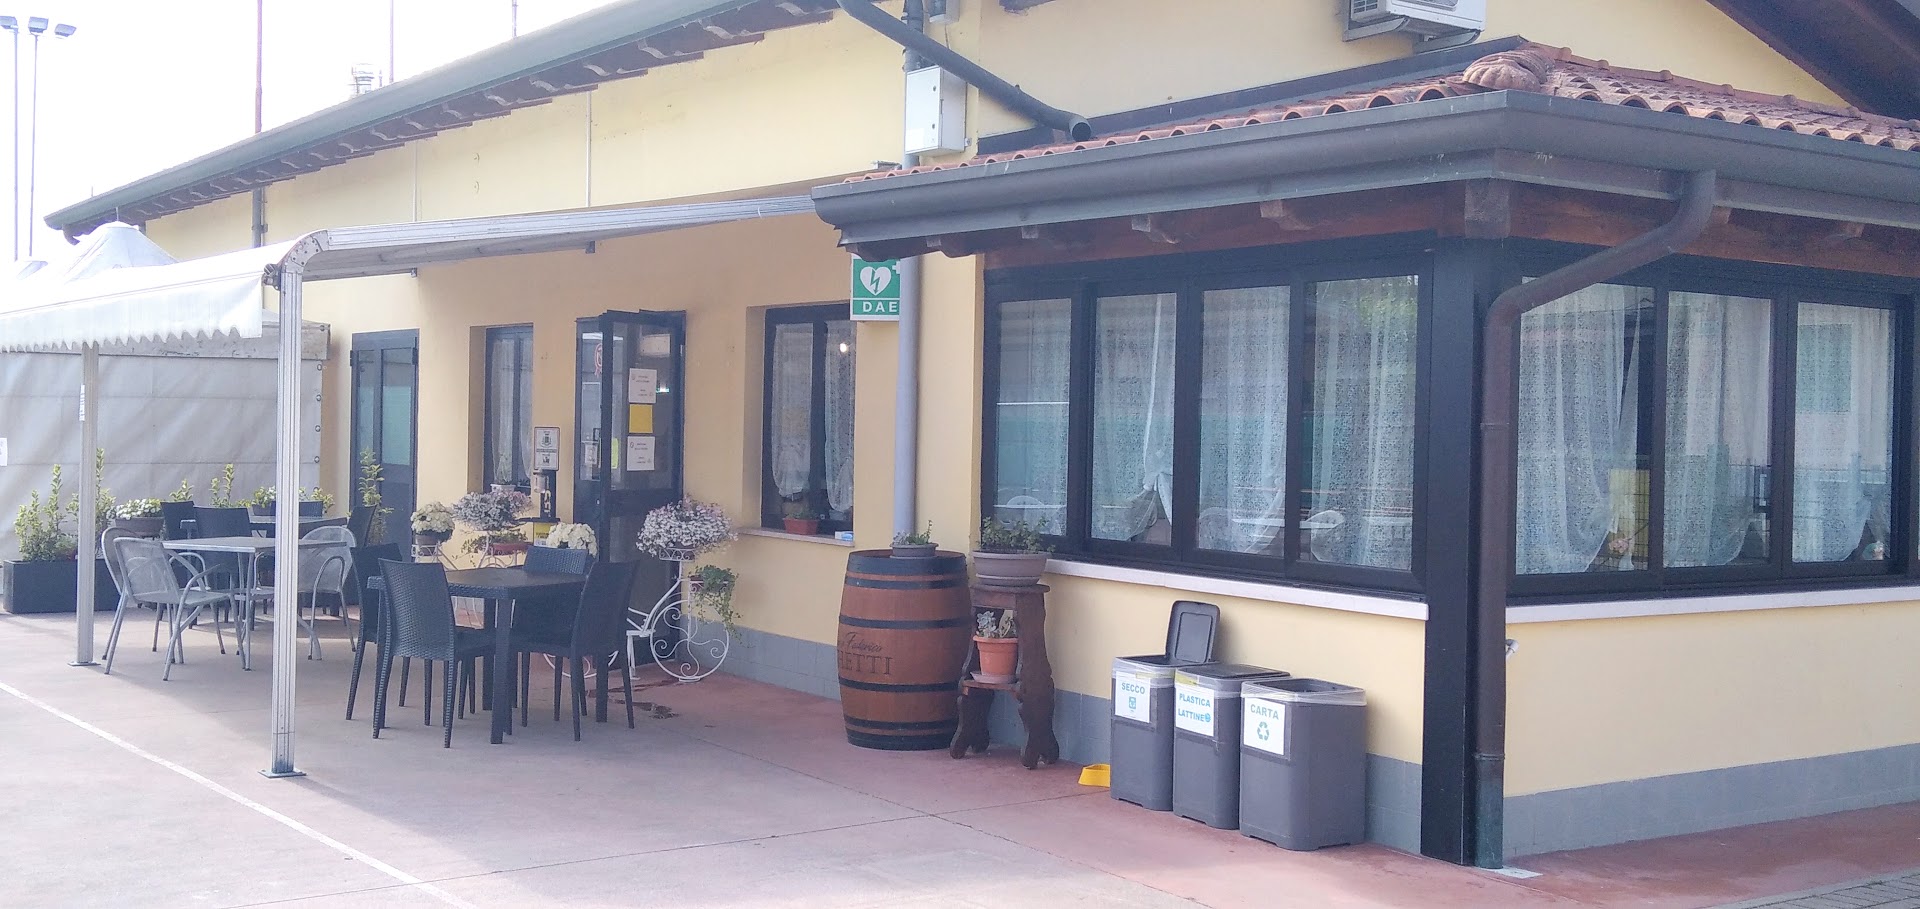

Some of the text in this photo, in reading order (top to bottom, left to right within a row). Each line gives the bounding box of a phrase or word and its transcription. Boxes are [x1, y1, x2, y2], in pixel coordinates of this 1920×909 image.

[862, 301, 898, 313] DAE
[1121, 682, 1146, 695] SECCO
[1179, 693, 1211, 707] PLASTICA
[1250, 704, 1279, 720] CARTA
